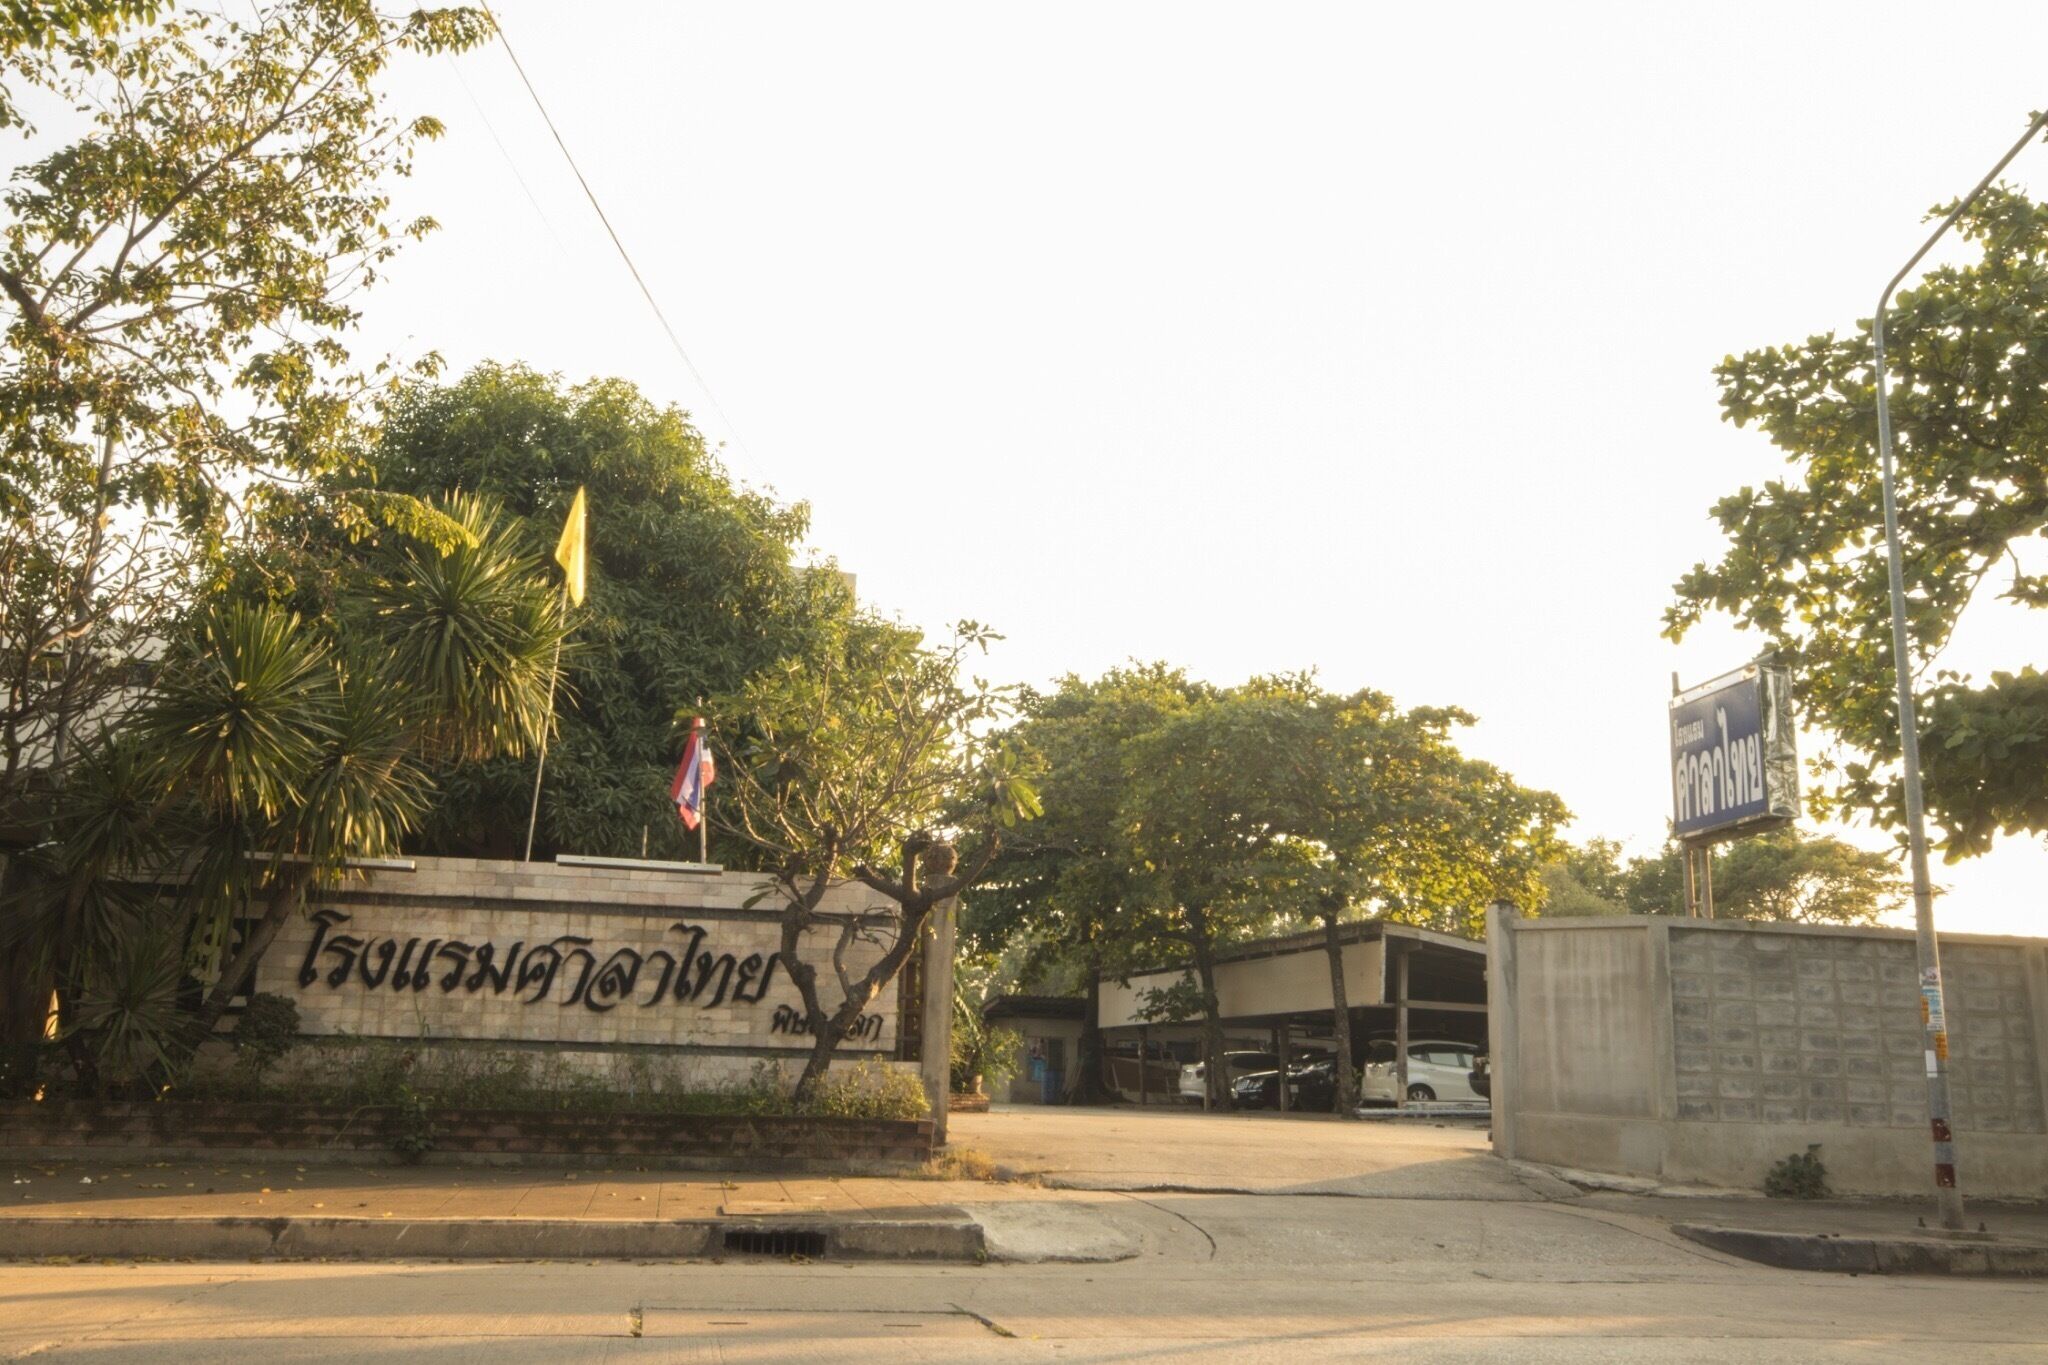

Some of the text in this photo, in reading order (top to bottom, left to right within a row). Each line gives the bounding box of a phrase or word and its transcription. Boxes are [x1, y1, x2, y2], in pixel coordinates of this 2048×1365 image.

[1676, 707, 1763, 822] ศาลาไทย
[299, 909, 781, 1011] โรงแรมศาลาไทย
